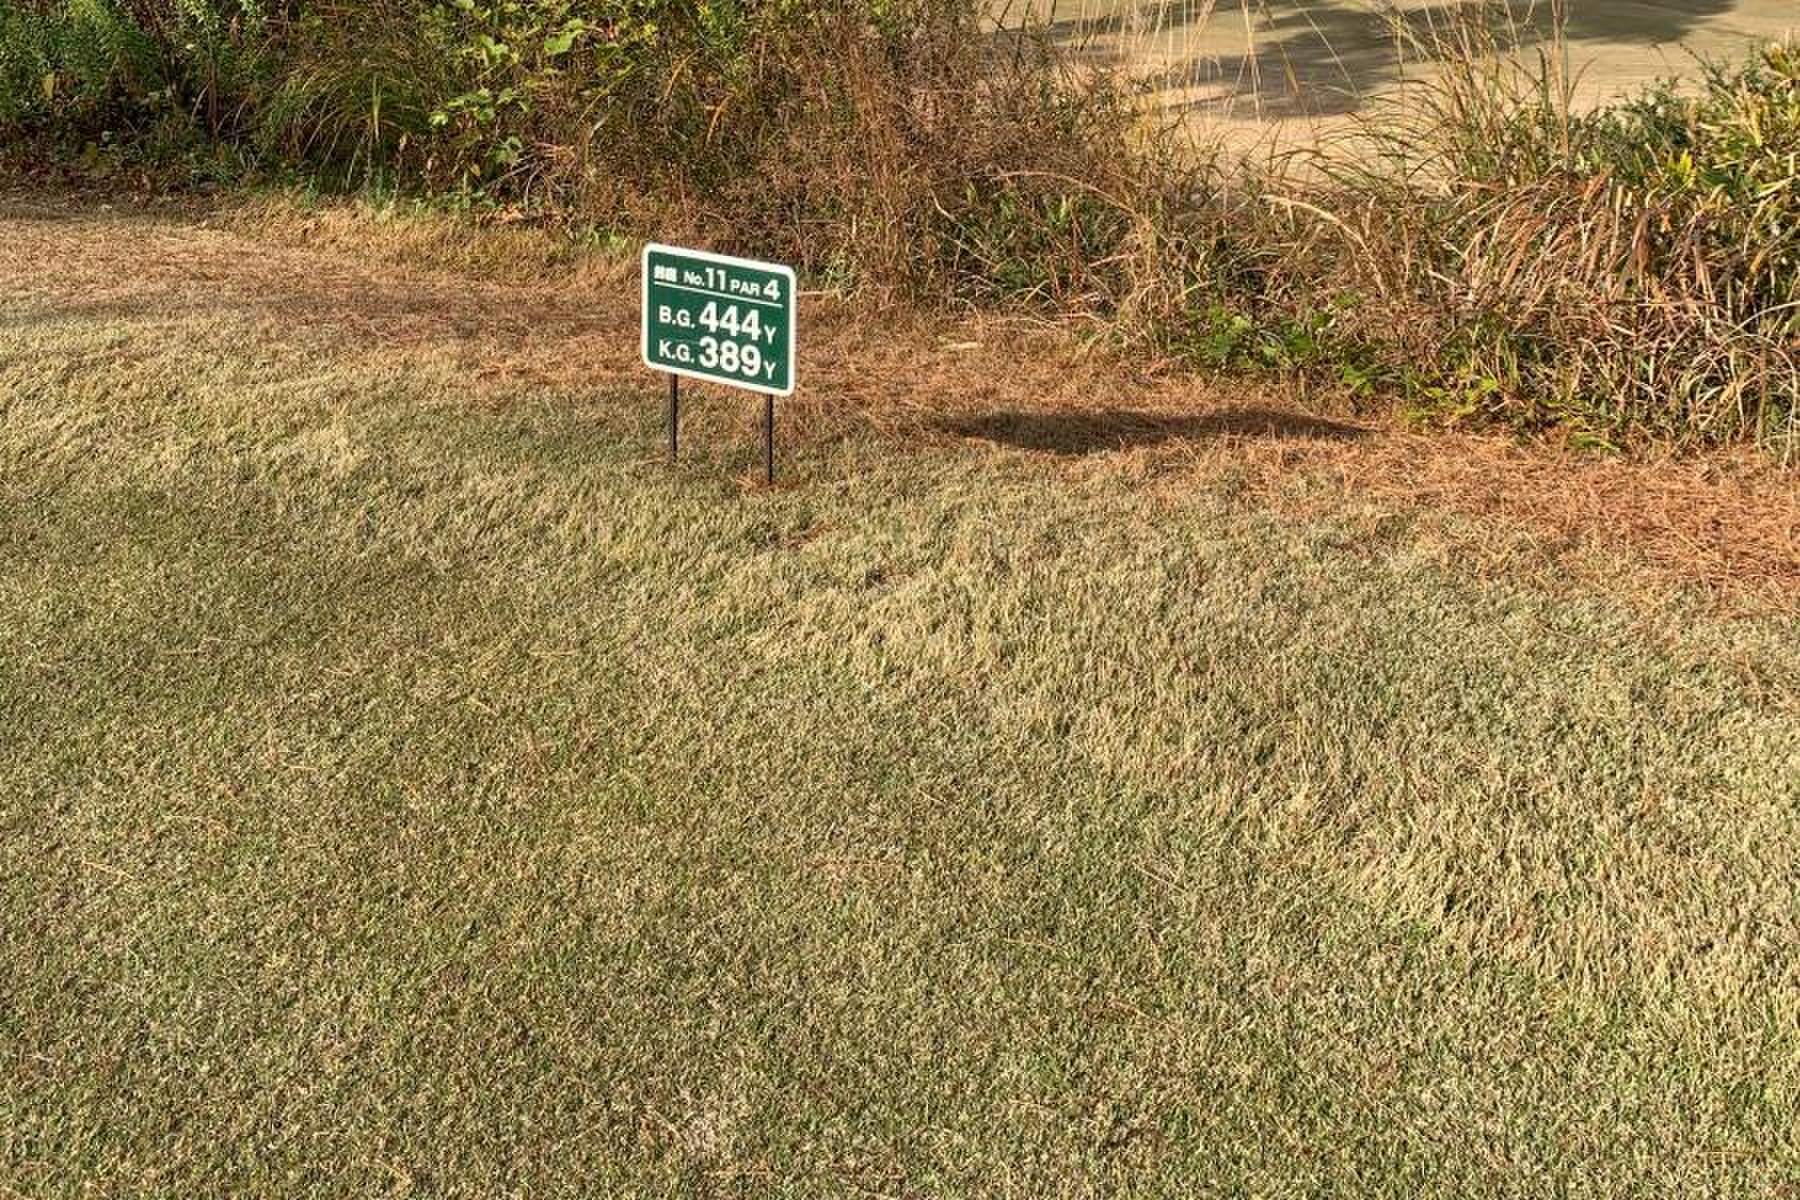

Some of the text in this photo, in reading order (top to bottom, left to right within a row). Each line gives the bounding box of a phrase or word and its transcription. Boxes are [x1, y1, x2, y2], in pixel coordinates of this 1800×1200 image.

[730, 279, 760, 296] PAR
[763, 279, 781, 301] 4
[659, 305, 696, 329] B.G.
[659, 340, 695, 364] K.G.
